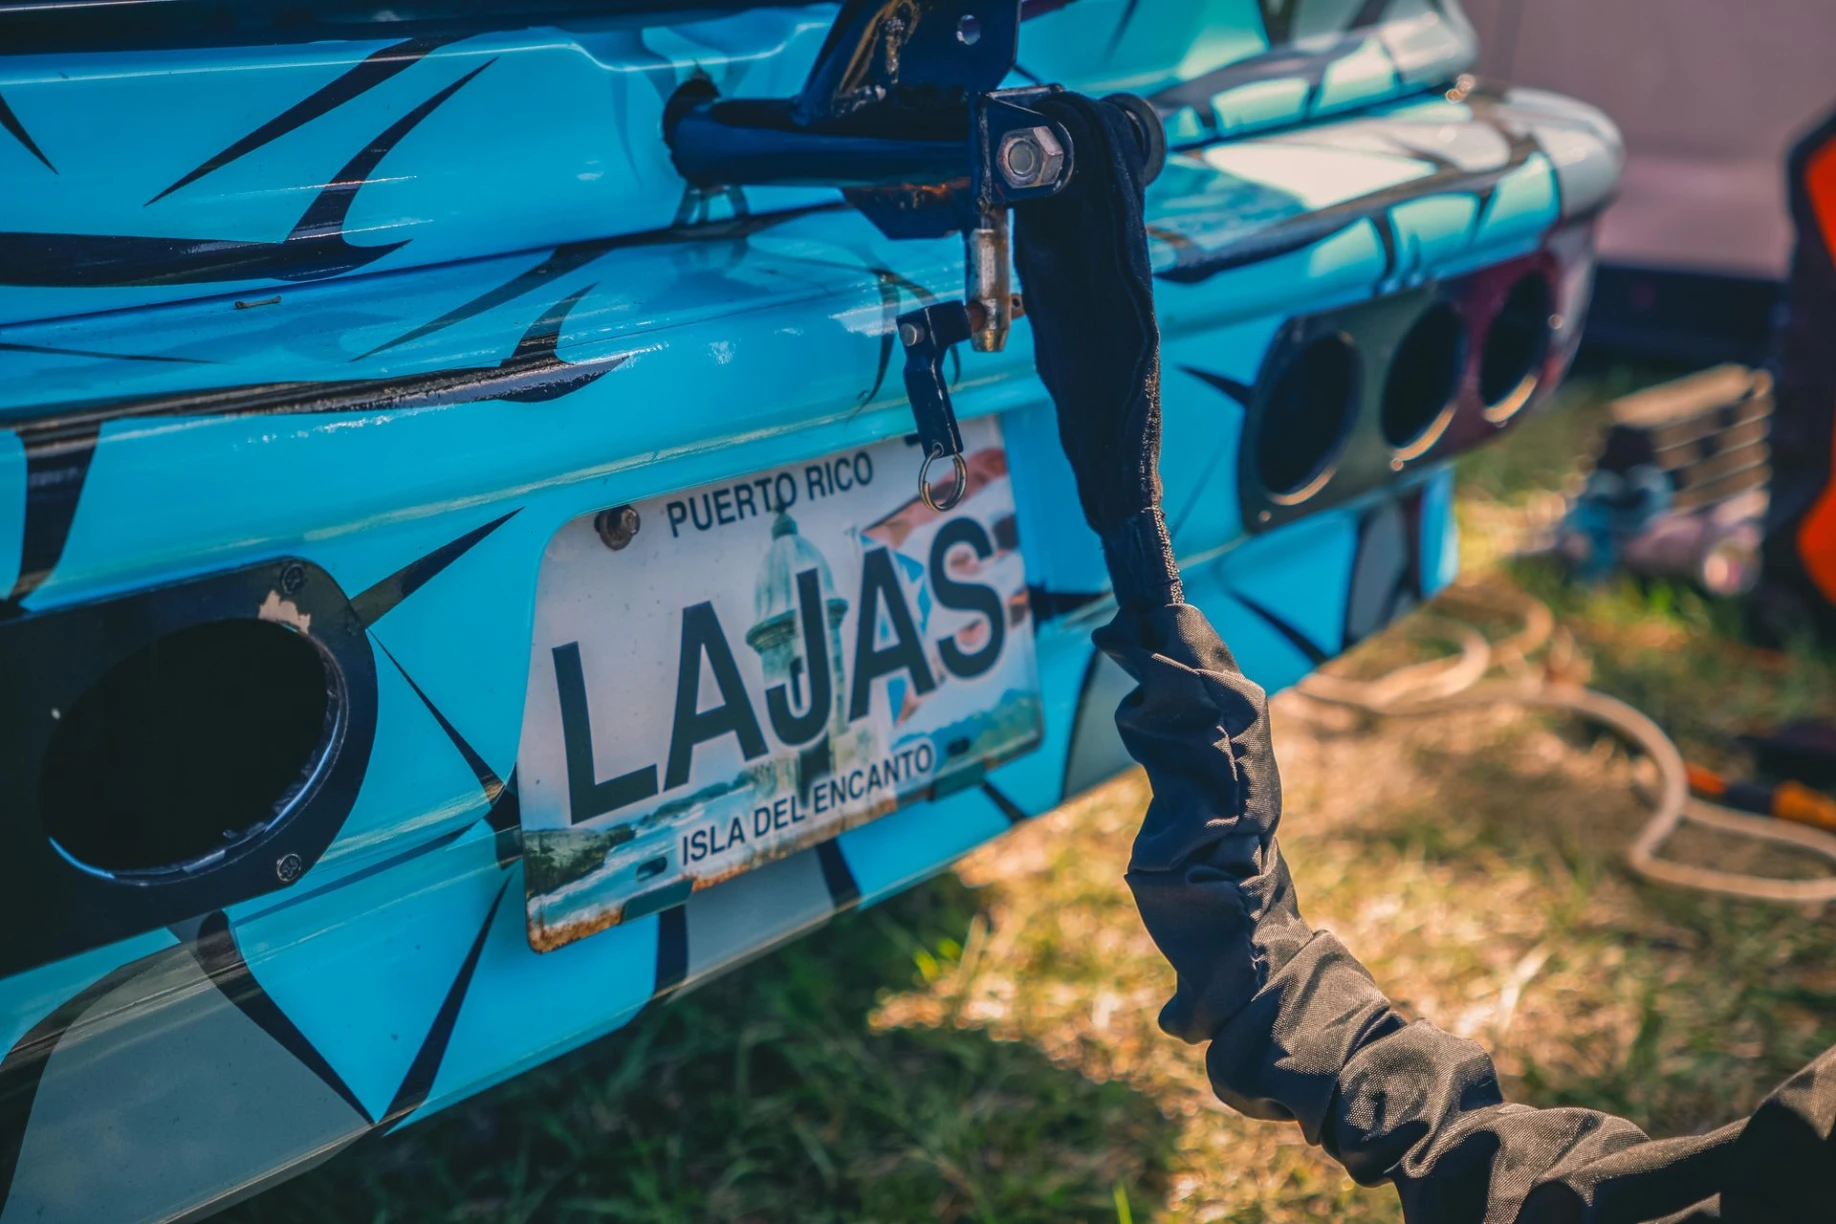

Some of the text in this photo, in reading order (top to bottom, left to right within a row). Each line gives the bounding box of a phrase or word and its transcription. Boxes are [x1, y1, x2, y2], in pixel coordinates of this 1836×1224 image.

[666, 451, 873, 537] PUERTO RICO
[551, 516, 1006, 825] LAJAS
[681, 743, 934, 866] ISLA DEL ENCANTO
